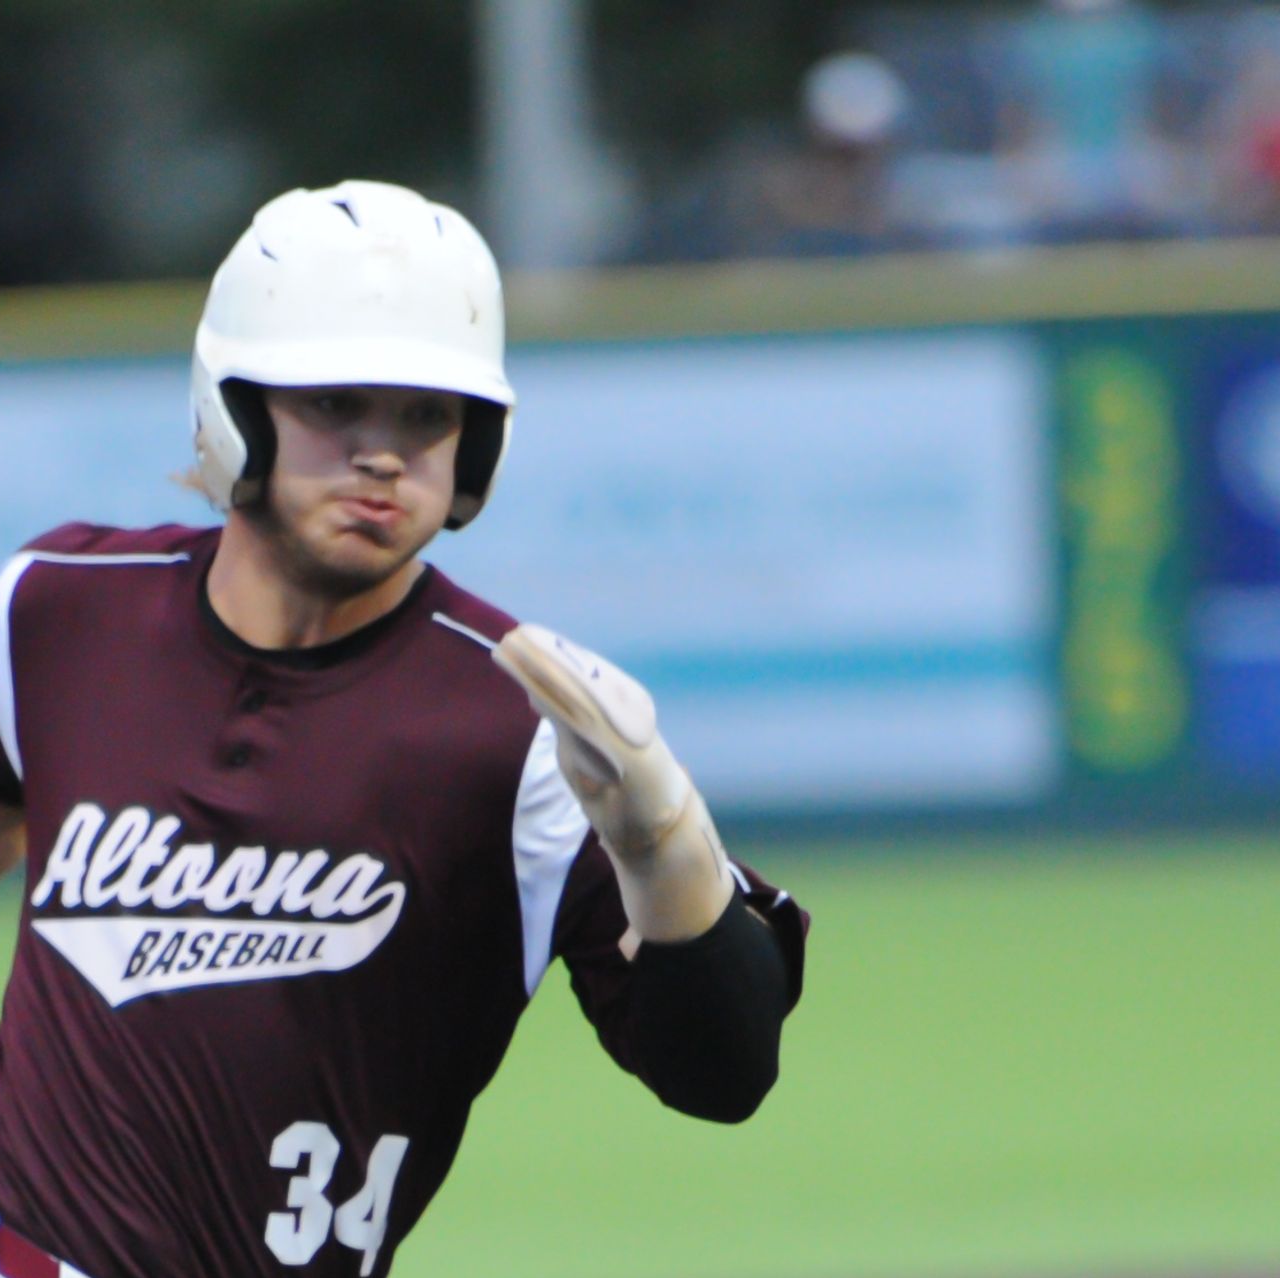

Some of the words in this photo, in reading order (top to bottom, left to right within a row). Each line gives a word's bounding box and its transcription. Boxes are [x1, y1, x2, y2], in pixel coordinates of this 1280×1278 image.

[31, 802, 406, 919] Altoona
[122, 930, 326, 980] BASEBALL
[264, 1121, 410, 1277] 34
